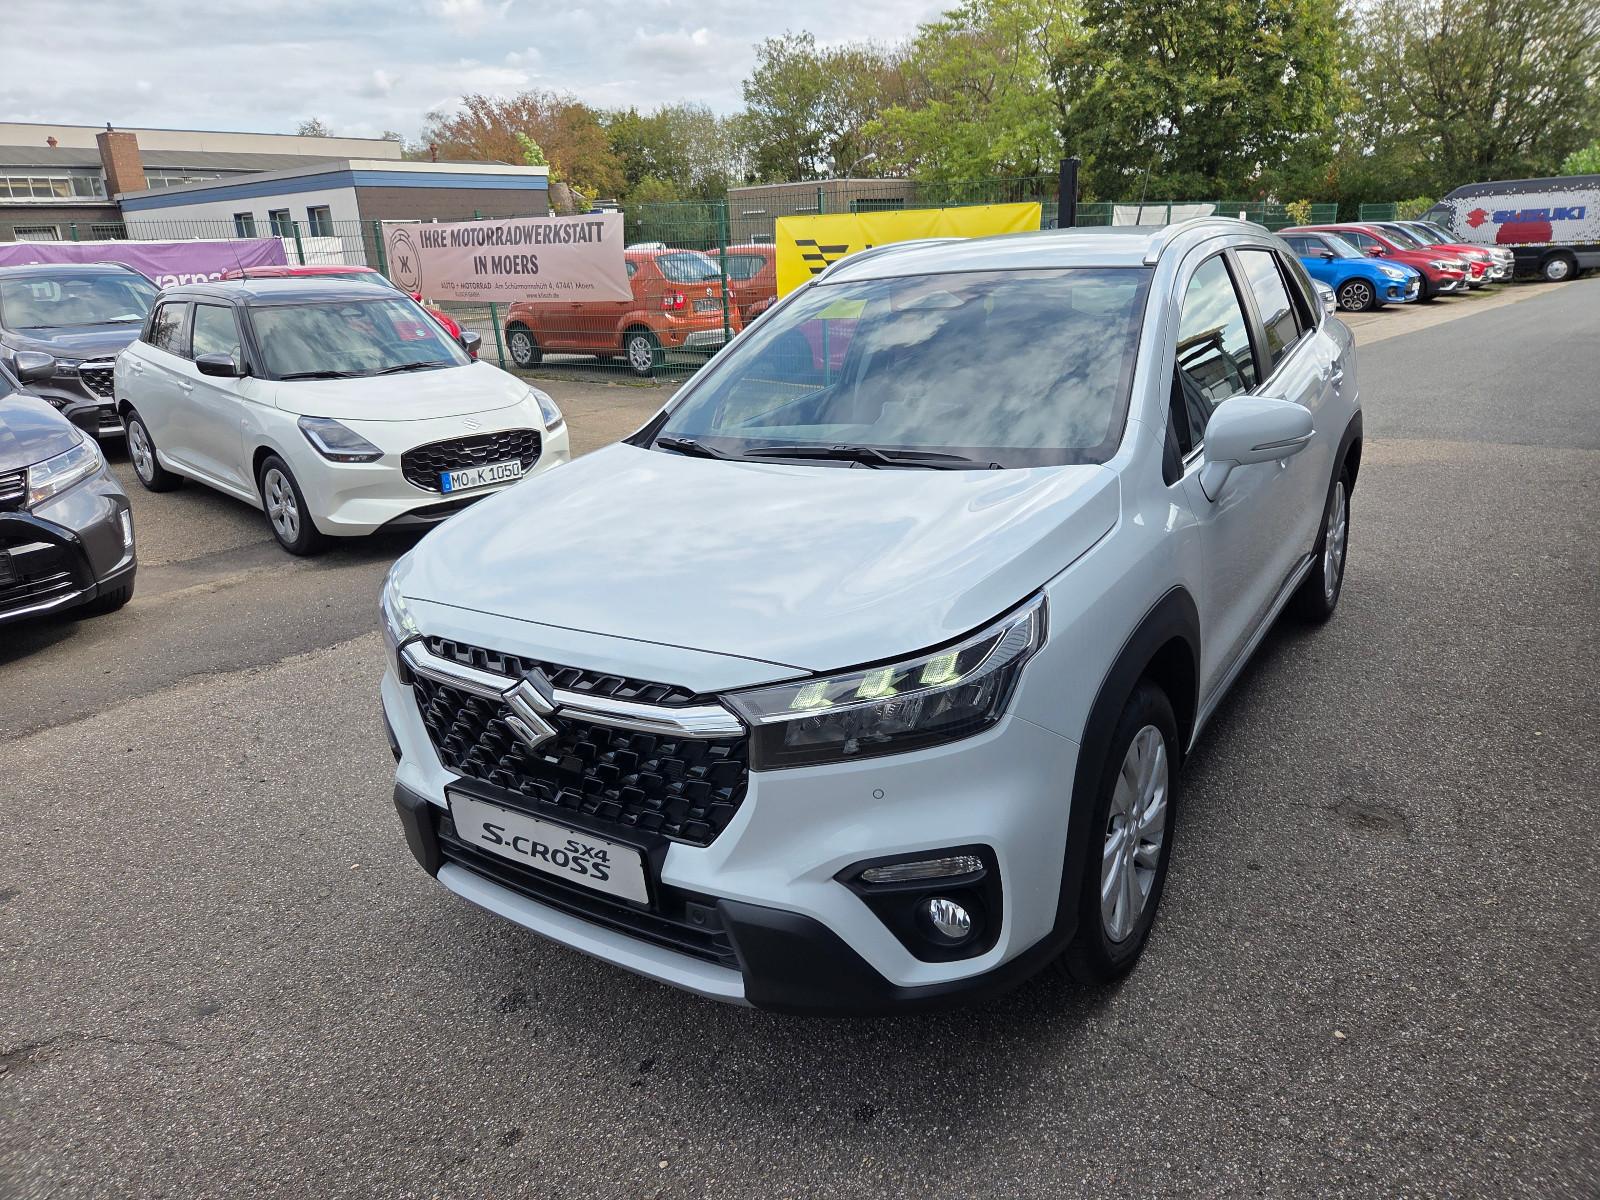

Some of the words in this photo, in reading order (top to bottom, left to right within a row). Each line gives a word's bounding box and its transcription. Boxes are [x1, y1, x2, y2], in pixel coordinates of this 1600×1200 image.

[1493, 206, 1587, 224] SUZUKI
[420, 229, 447, 249] IHRE
[450, 221, 605, 248] MOTORRADWERKSTATT
[473, 255, 488, 275] IN
[491, 254, 539, 275] MOERS
[556, 282, 574, 290] 47441
[451, 472, 469, 489] MO
[477, 469, 487, 484] K
[489, 463, 520, 481] 1050
[481, 822, 611, 882] S.CROSS
[564, 839, 611, 864] SX4
